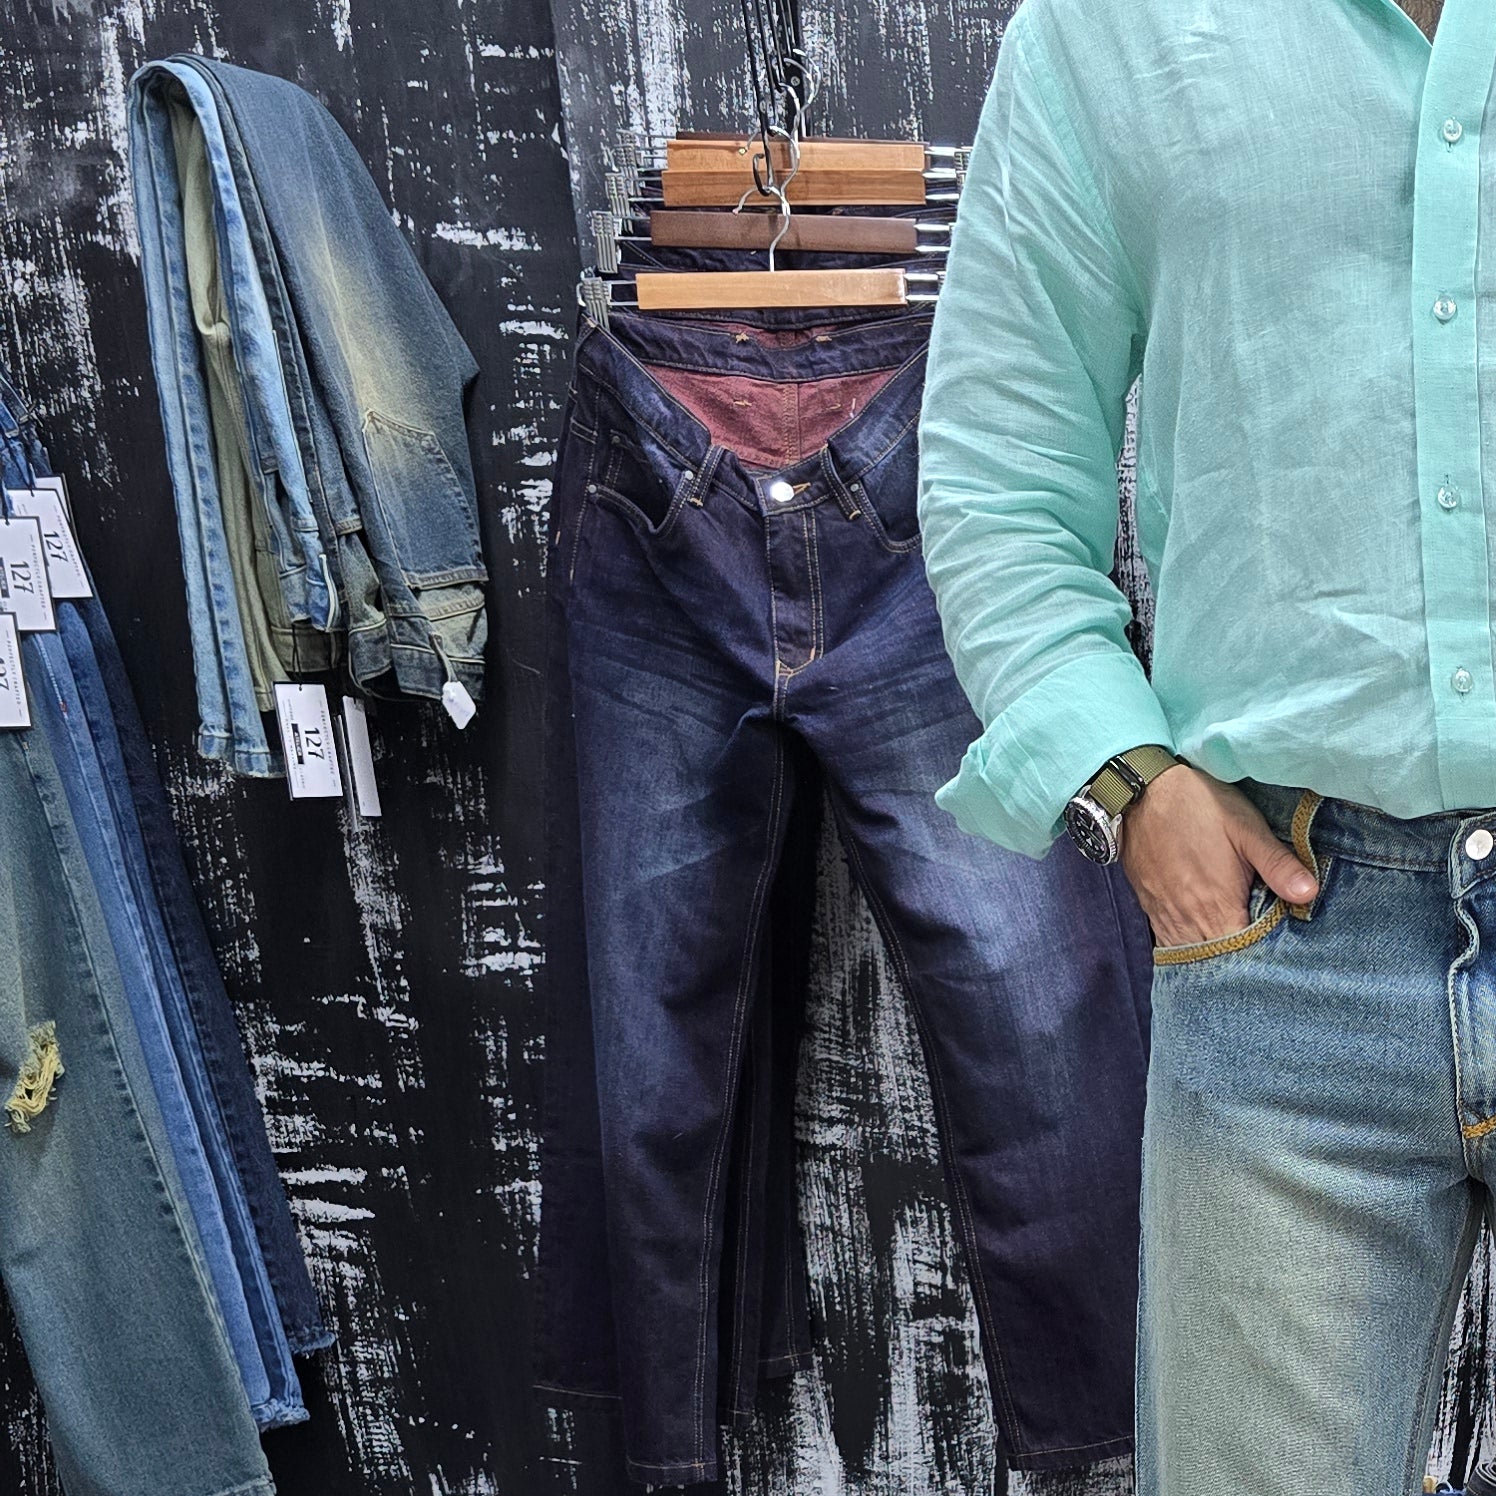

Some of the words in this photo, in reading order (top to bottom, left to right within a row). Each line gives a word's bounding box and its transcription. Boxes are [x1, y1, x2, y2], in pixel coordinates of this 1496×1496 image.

[44, 531, 68, 562] 127
[10, 561, 34, 594] 127
[304, 727, 325, 760] 127
